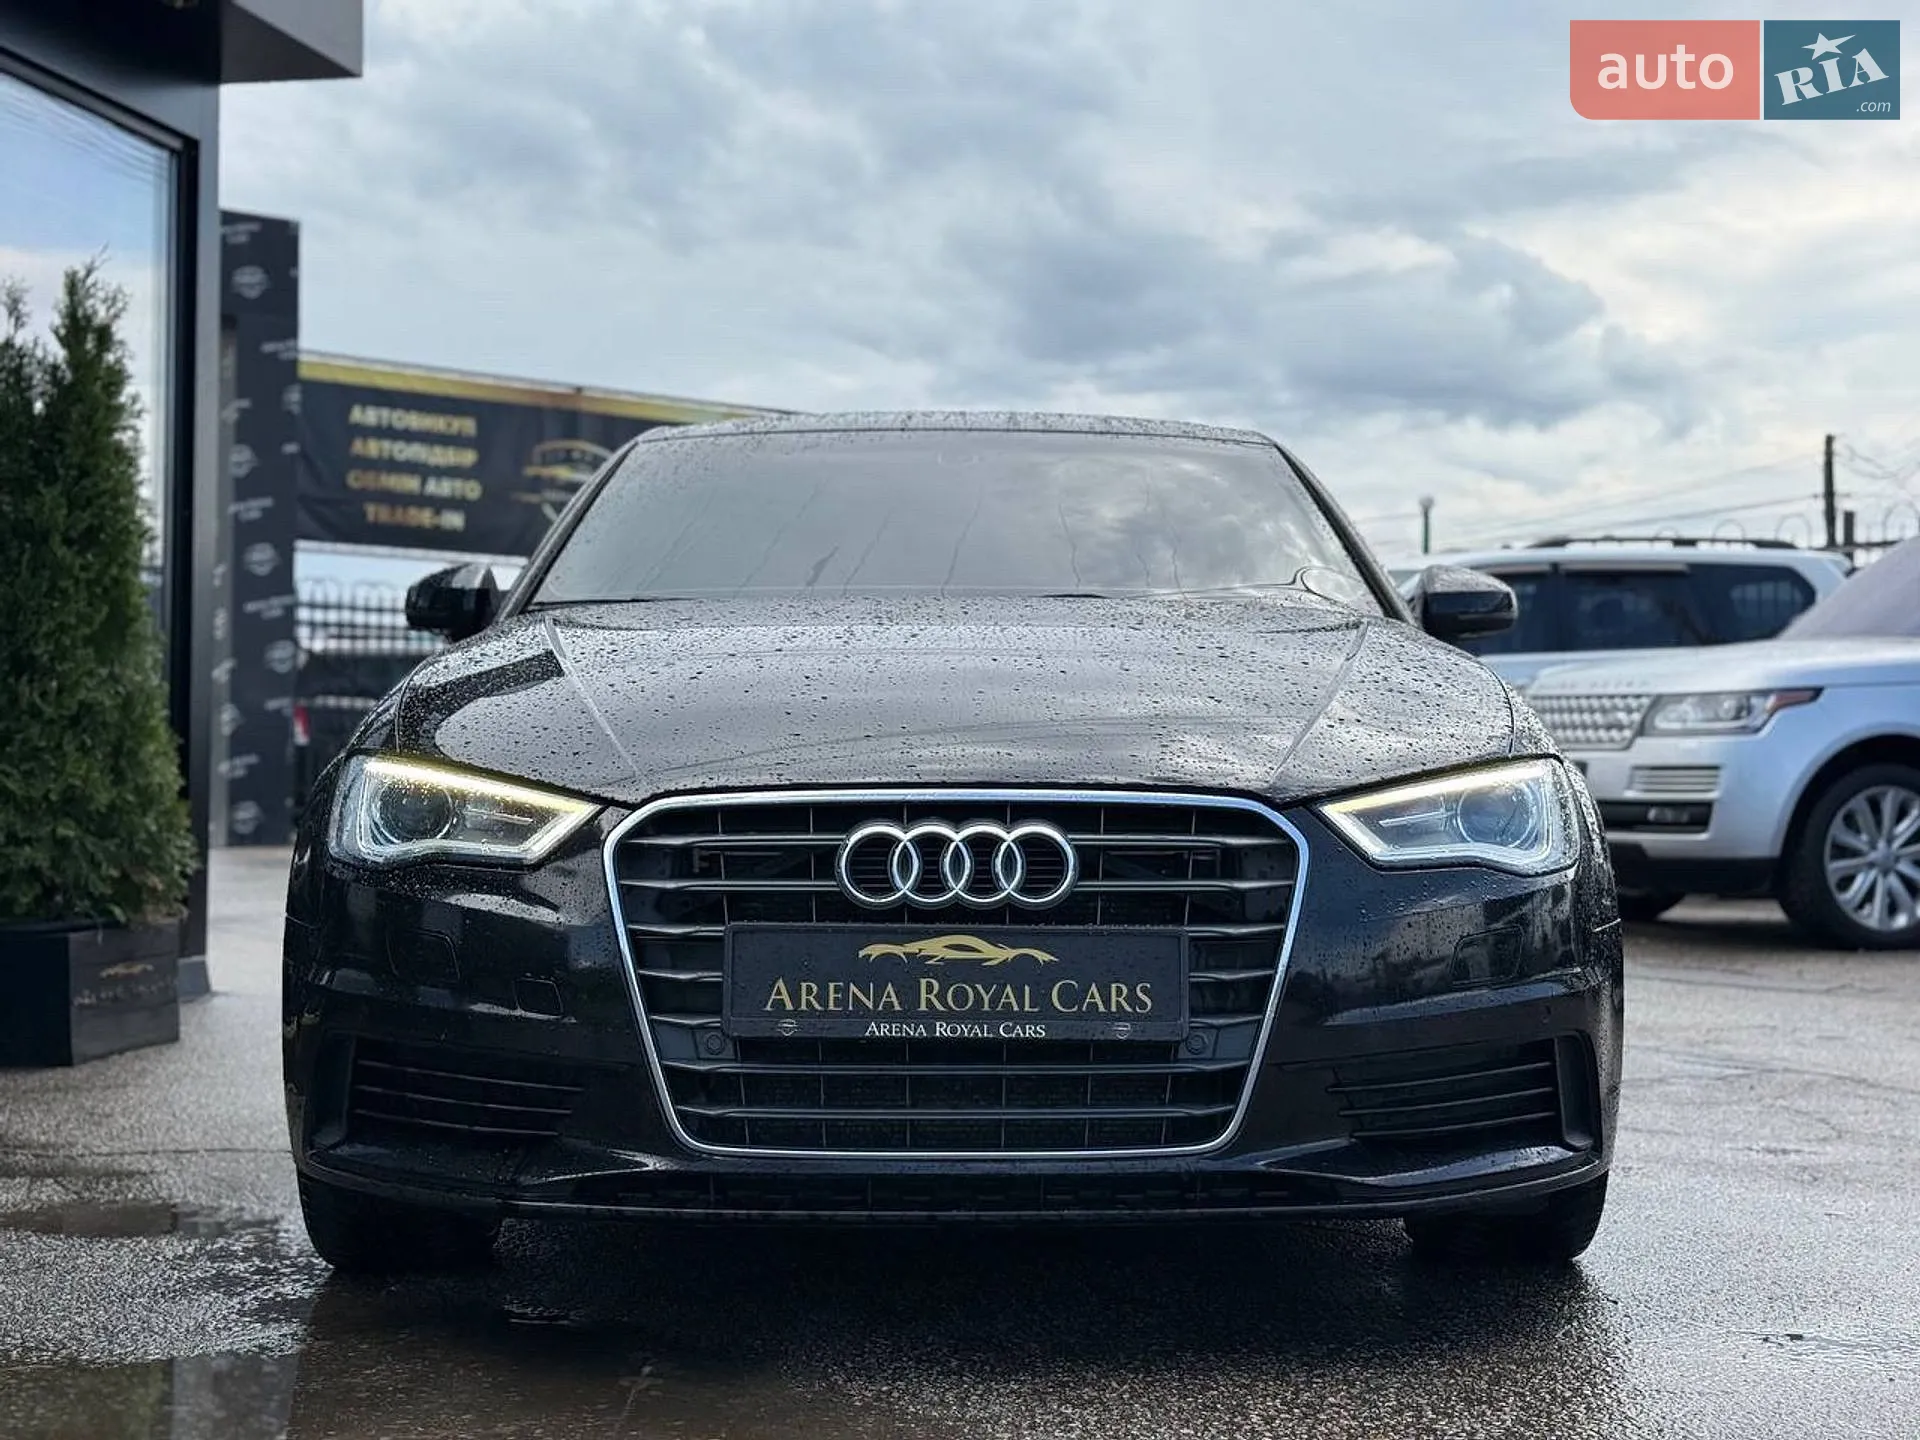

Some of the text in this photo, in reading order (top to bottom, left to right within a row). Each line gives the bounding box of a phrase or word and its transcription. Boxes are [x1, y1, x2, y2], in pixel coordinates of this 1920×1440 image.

[423, 476, 482, 501] АВТО
[363, 502, 466, 532] TRADE-IN
[764, 977, 1153, 1014] ARENA ROYAL CARS
[864, 1021, 1046, 1038] ARENA ROYAL CARS
